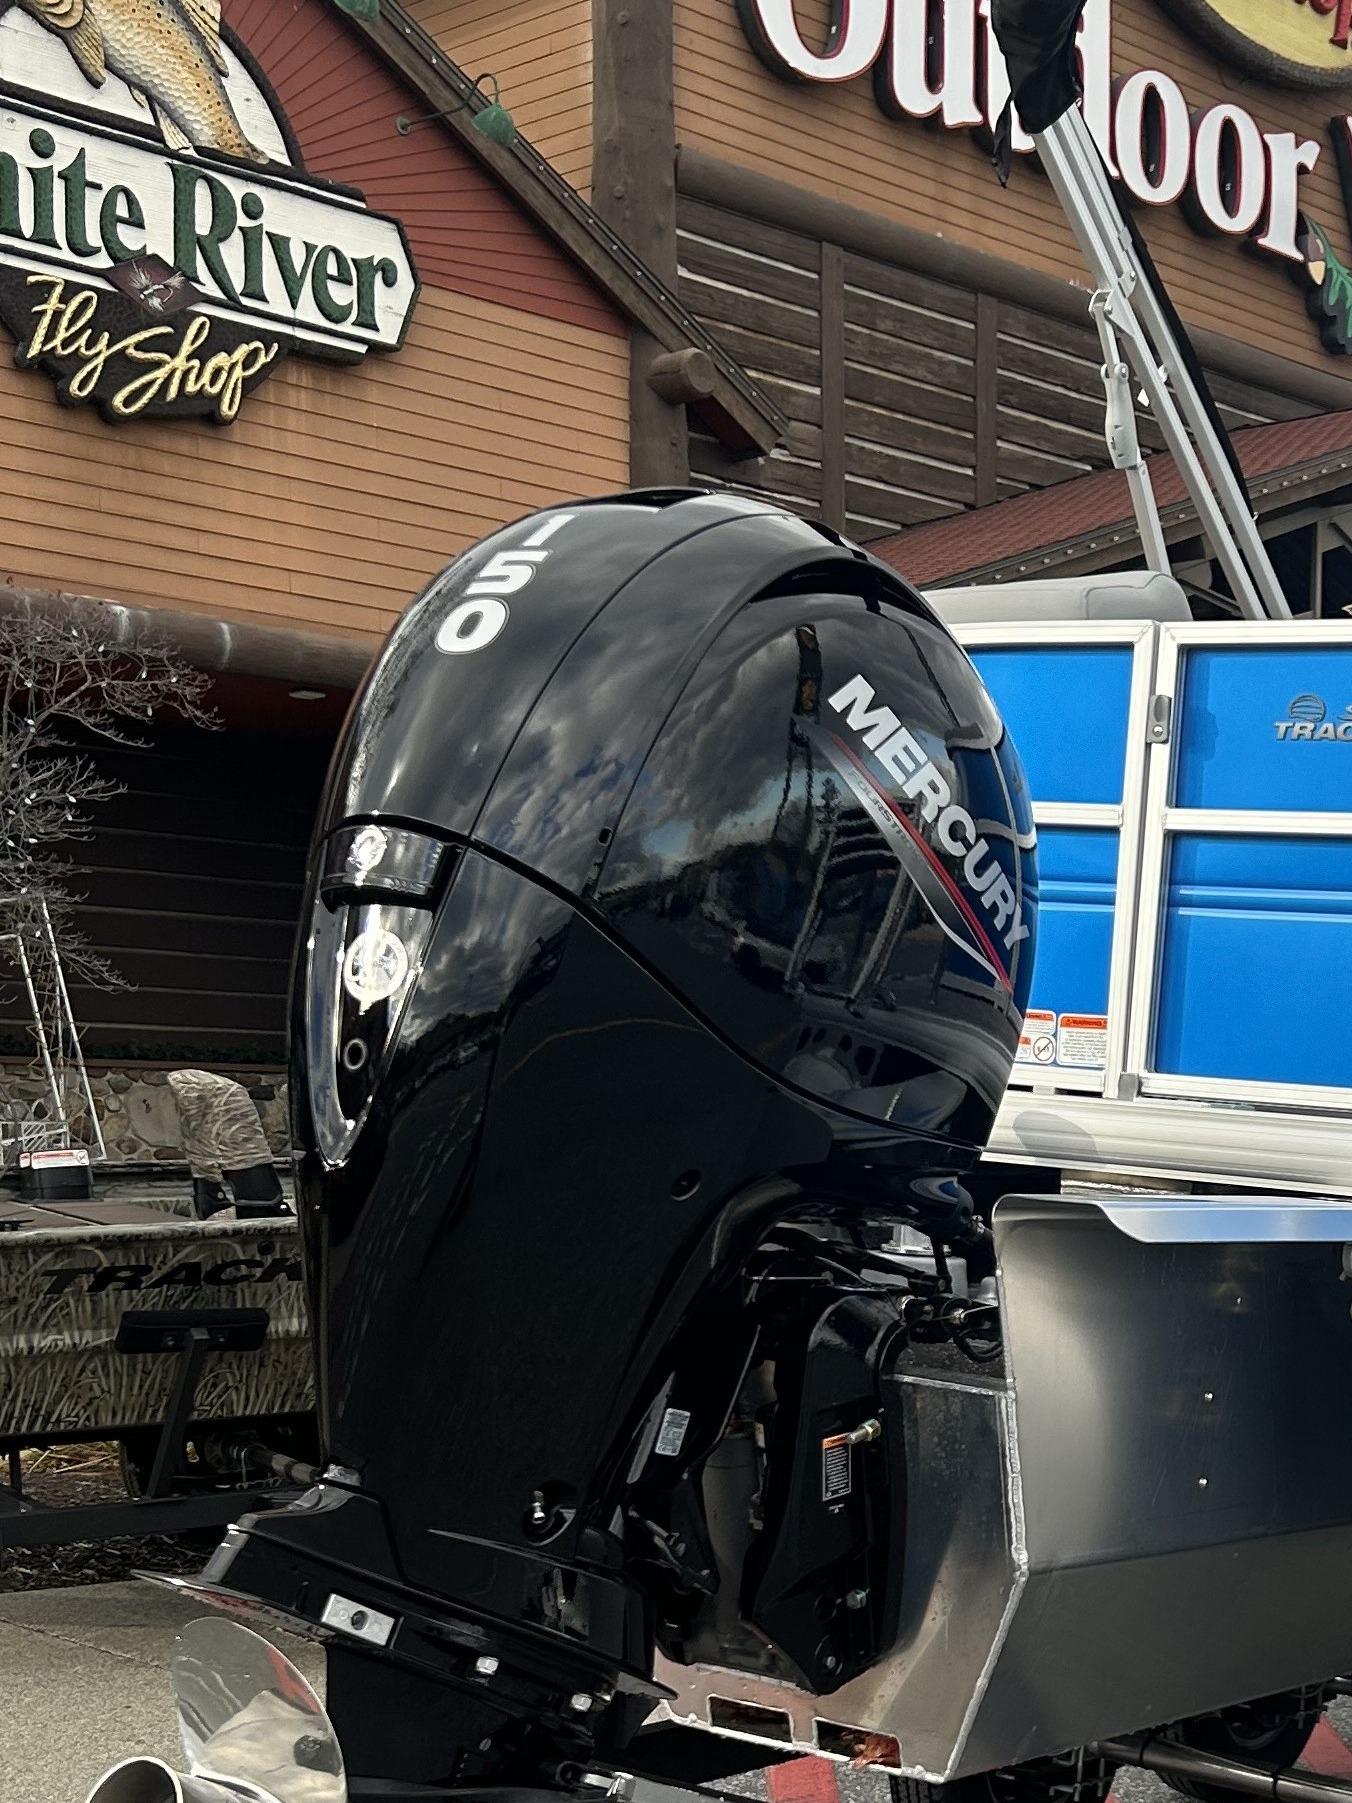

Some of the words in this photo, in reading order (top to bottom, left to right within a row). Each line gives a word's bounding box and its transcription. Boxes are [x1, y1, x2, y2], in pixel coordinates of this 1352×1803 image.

[0, 128, 147, 266] ite
[167, 161, 398, 332] River
[26, 275, 112, 398] Fly
[112, 316, 279, 420] Shop
[434, 514, 576, 656] 150
[827, 673, 1031, 951] MERCURY
